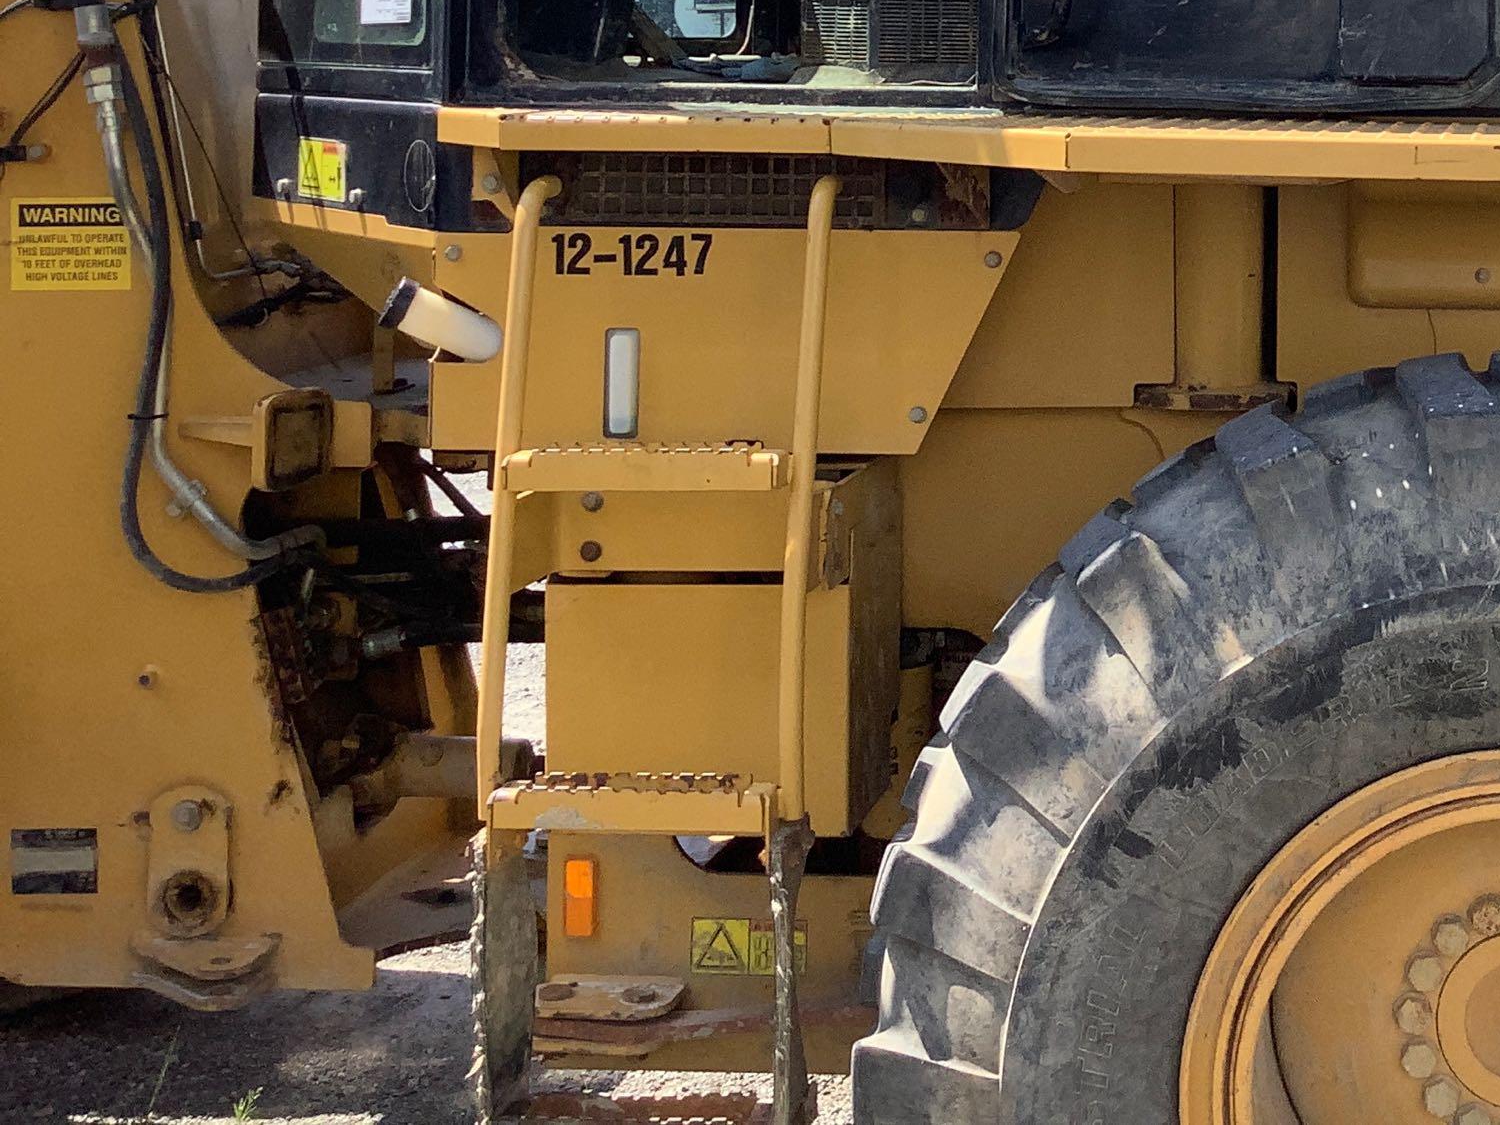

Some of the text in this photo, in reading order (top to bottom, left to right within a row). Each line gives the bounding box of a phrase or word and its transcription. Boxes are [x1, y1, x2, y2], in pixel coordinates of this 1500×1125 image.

[23, 208, 121, 223] WARNING
[19, 234, 124, 243] UNLAWFUL TO OPERATE
[17, 247, 127, 256] THIS EQUIPMENT WITHIN
[551, 232, 713, 277] 12-1247
[36, 259, 56, 268] FEET
[59, 259, 70, 268] OF
[74, 259, 122, 268] OVERHEAD
[26, 272, 118, 281] HIGH VOLTAGE LINES
